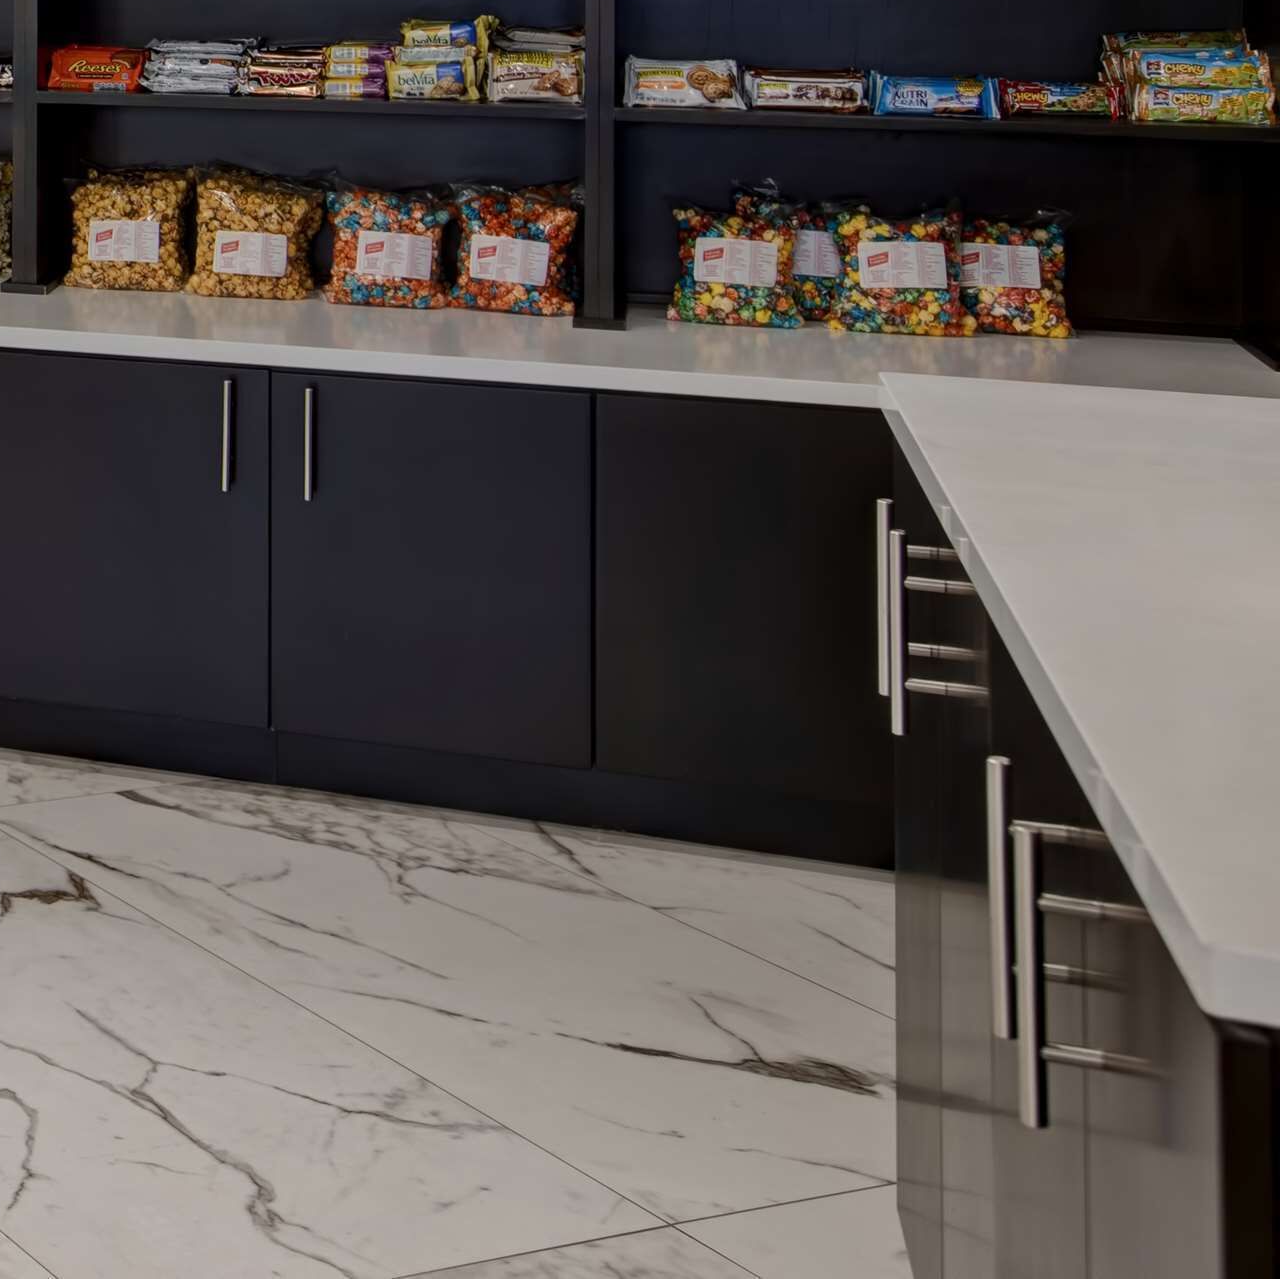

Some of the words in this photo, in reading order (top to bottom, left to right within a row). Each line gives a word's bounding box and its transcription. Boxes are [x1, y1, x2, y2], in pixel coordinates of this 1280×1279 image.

[68, 59, 121, 73] Reese's
[1164, 63, 1207, 76] CHEWY
[397, 71, 435, 86] belVita
[1172, 94, 1211, 106] CHEWY
